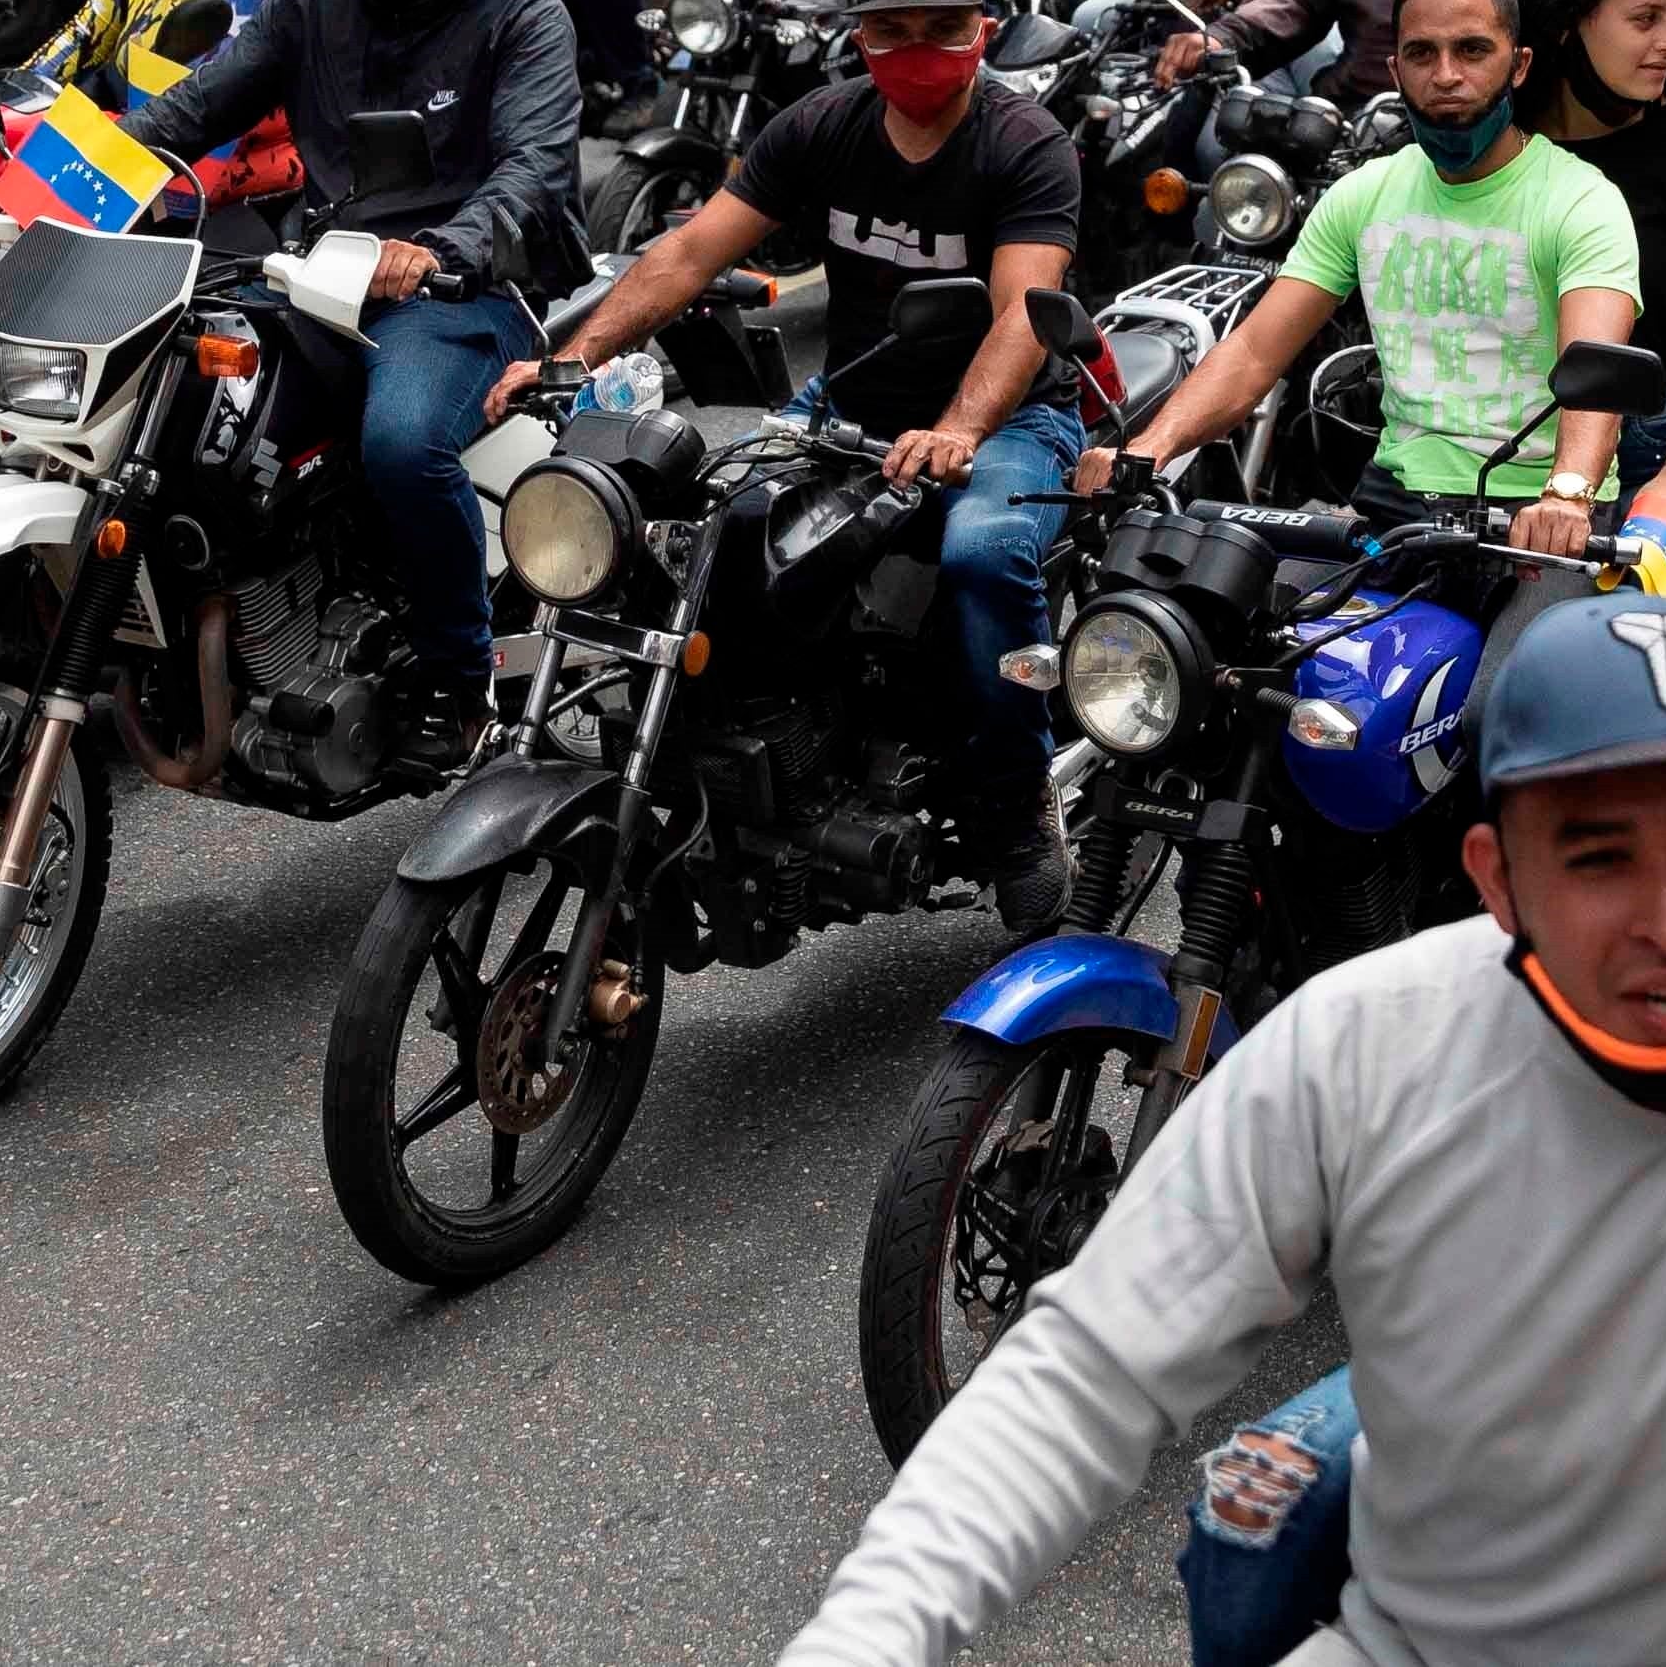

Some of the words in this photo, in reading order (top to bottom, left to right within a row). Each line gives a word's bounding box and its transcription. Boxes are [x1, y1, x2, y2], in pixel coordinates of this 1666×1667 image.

[433, 89, 458, 104] NIKE
[297, 454, 324, 480] DR
[1220, 506, 1313, 527] BERA
[1125, 801, 1194, 821] BERA
